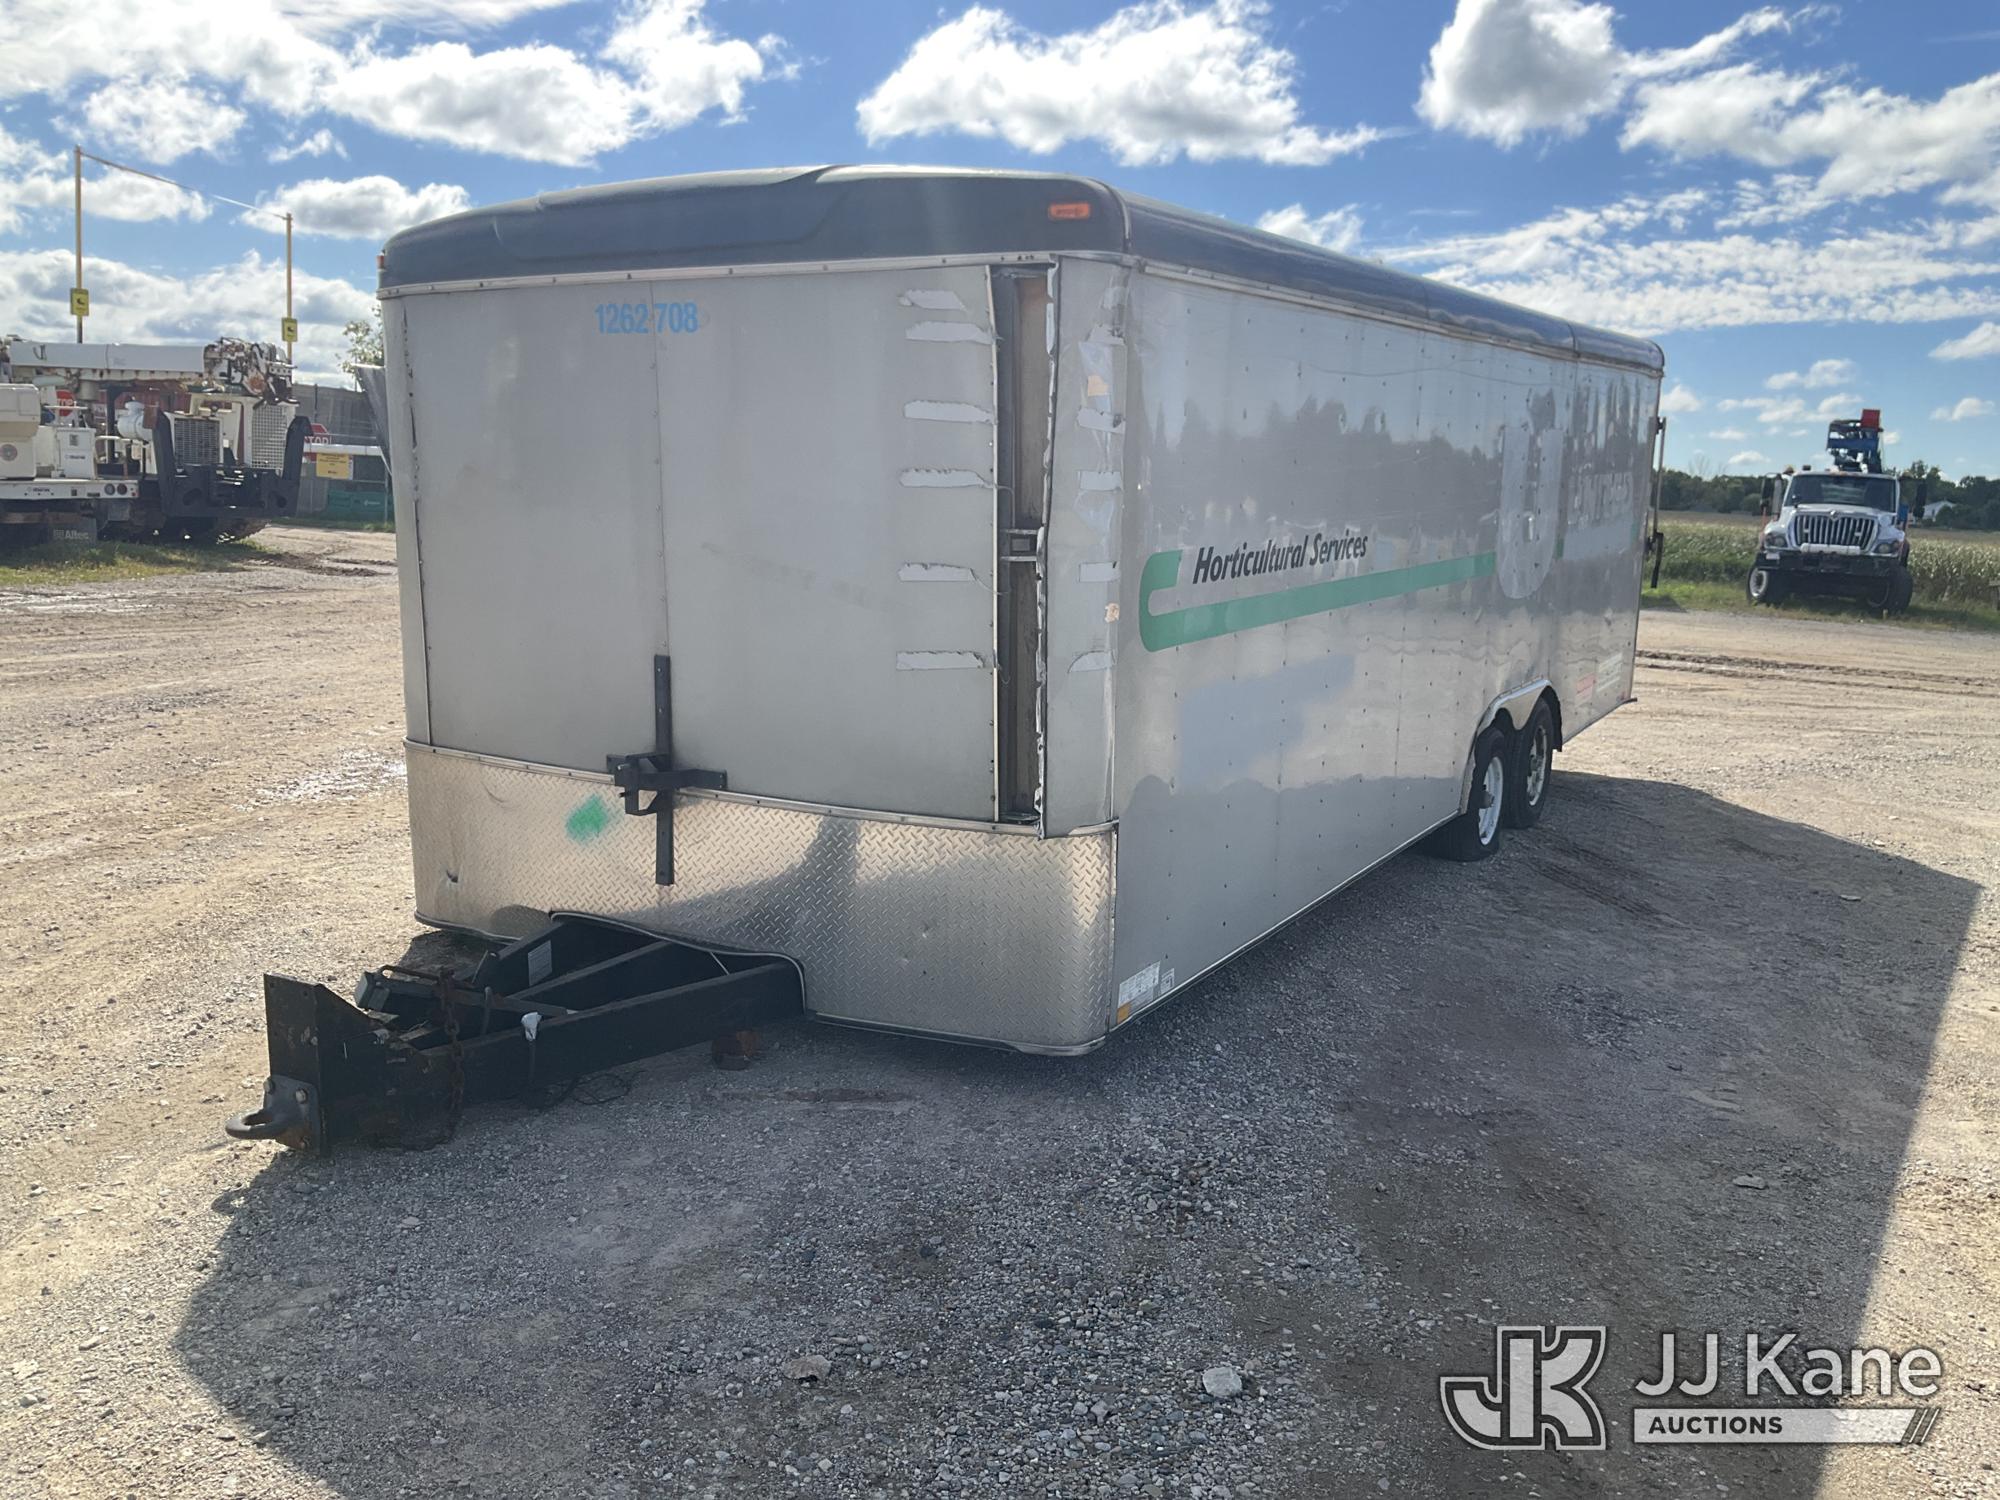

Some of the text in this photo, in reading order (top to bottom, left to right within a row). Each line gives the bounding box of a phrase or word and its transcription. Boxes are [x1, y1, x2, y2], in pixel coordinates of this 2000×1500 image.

[594, 302, 699, 334] 1262708
[1192, 529, 1369, 584] Horticultural Services
